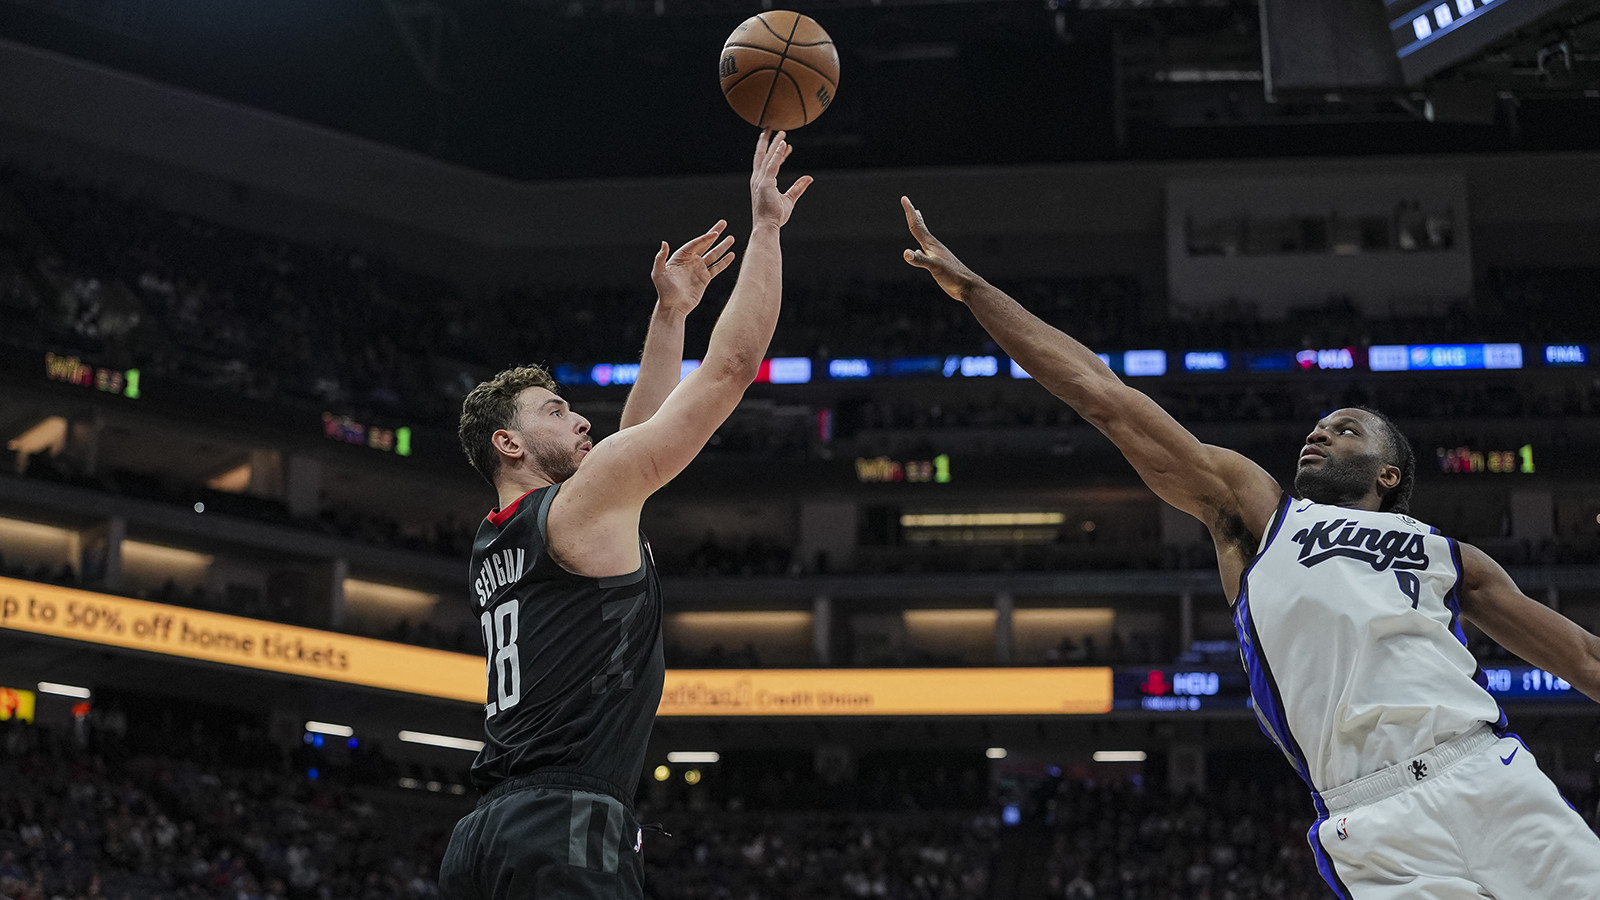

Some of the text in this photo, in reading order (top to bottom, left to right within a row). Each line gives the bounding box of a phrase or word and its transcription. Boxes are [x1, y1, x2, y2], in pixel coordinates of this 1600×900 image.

[934, 454, 952, 483] 1
[1519, 444, 1536, 473] 1
[1291, 519, 1429, 571] Kings
[475, 548, 525, 607] SENGUN
[1, 597, 349, 671] p to 50% off home tickets
[755, 689, 814, 705] Credit
[817, 690, 874, 705] Union
[1173, 672, 1219, 695] HOU
